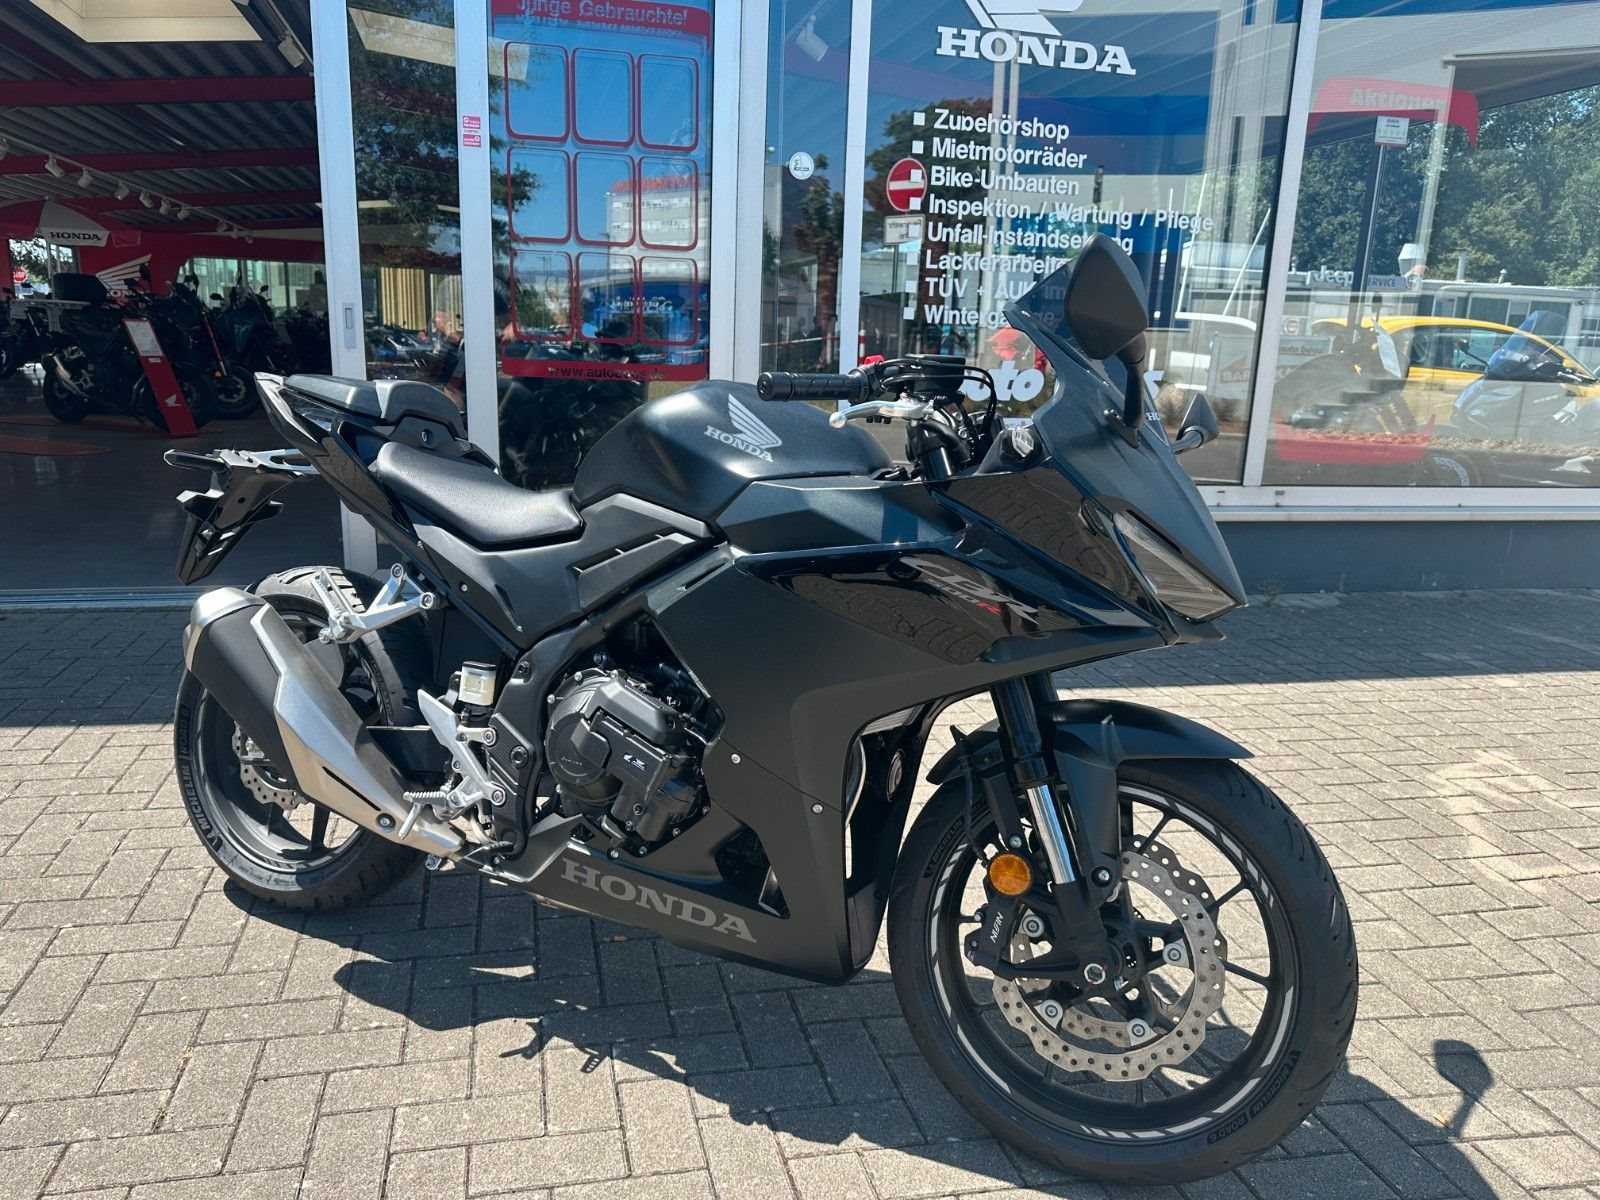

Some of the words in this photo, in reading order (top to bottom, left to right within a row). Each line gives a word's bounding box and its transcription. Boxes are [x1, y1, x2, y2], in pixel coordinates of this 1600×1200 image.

[579, 0, 688, 26] Gebrauchte!
[936, 26, 1137, 76] HONDA
[933, 108, 1070, 144] Zubehörshop
[932, 137, 1088, 169] Mietmotorräder
[930, 165, 1080, 195] Bike-Umbauten
[928, 193, 1031, 219] Inspektion
[1054, 202, 1133, 230] Wartung
[1155, 209, 1214, 233] Pflege
[50, 231, 102, 241] HONDA
[927, 222, 1134, 255] Unfall-Instandsetg
[925, 249, 1068, 275] Lackierarbeite
[1314, 265, 1355, 287] Jeep
[1367, 276, 1397, 288] ERVICE
[925, 274, 968, 298] TÜV
[957, 361, 1045, 402] uto
[703, 424, 774, 463] HONDA
[181, 762, 212, 831] MICHELIN
[561, 857, 758, 944] HONDA
[1251, 1066, 1291, 1116] MICHELIN
